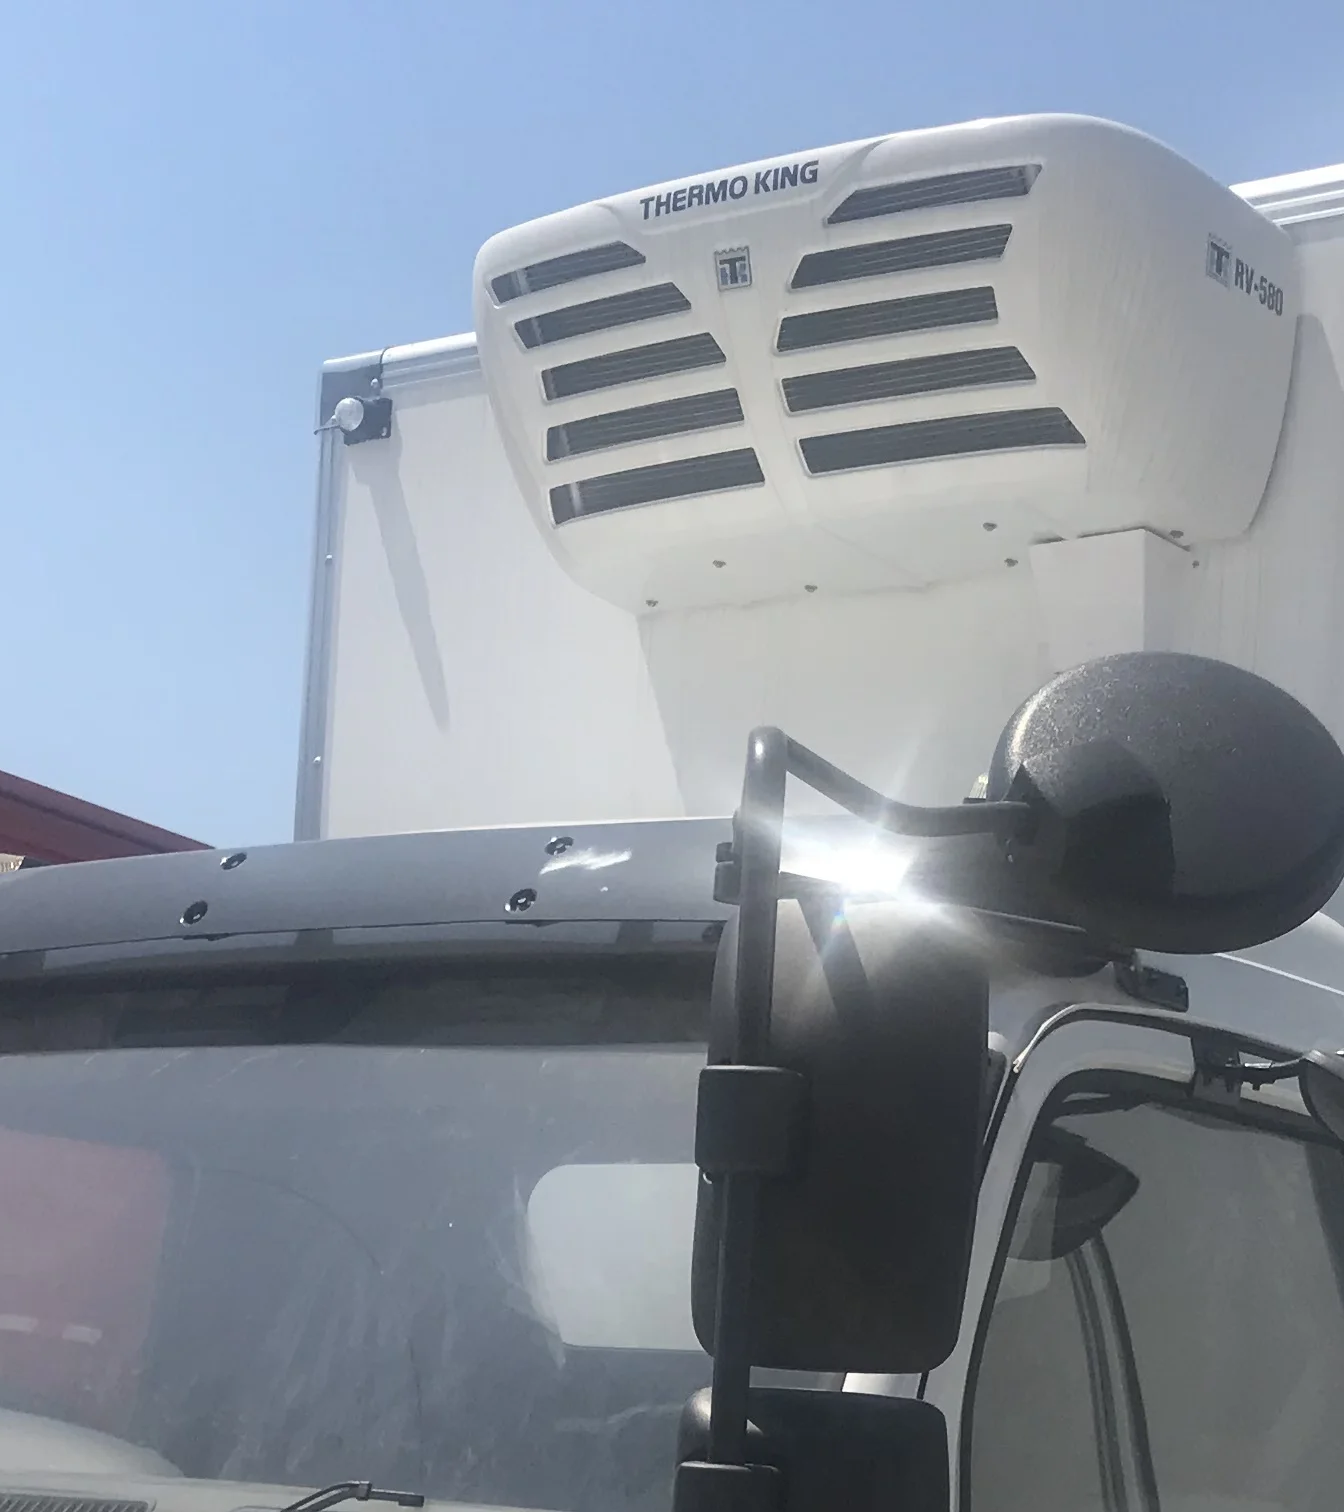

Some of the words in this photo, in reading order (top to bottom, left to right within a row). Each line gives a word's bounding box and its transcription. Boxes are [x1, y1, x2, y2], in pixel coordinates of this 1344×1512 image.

[640, 176, 748, 220] THERMO
[755, 160, 820, 194] KING
[1235, 258, 1284, 316] RV-580
